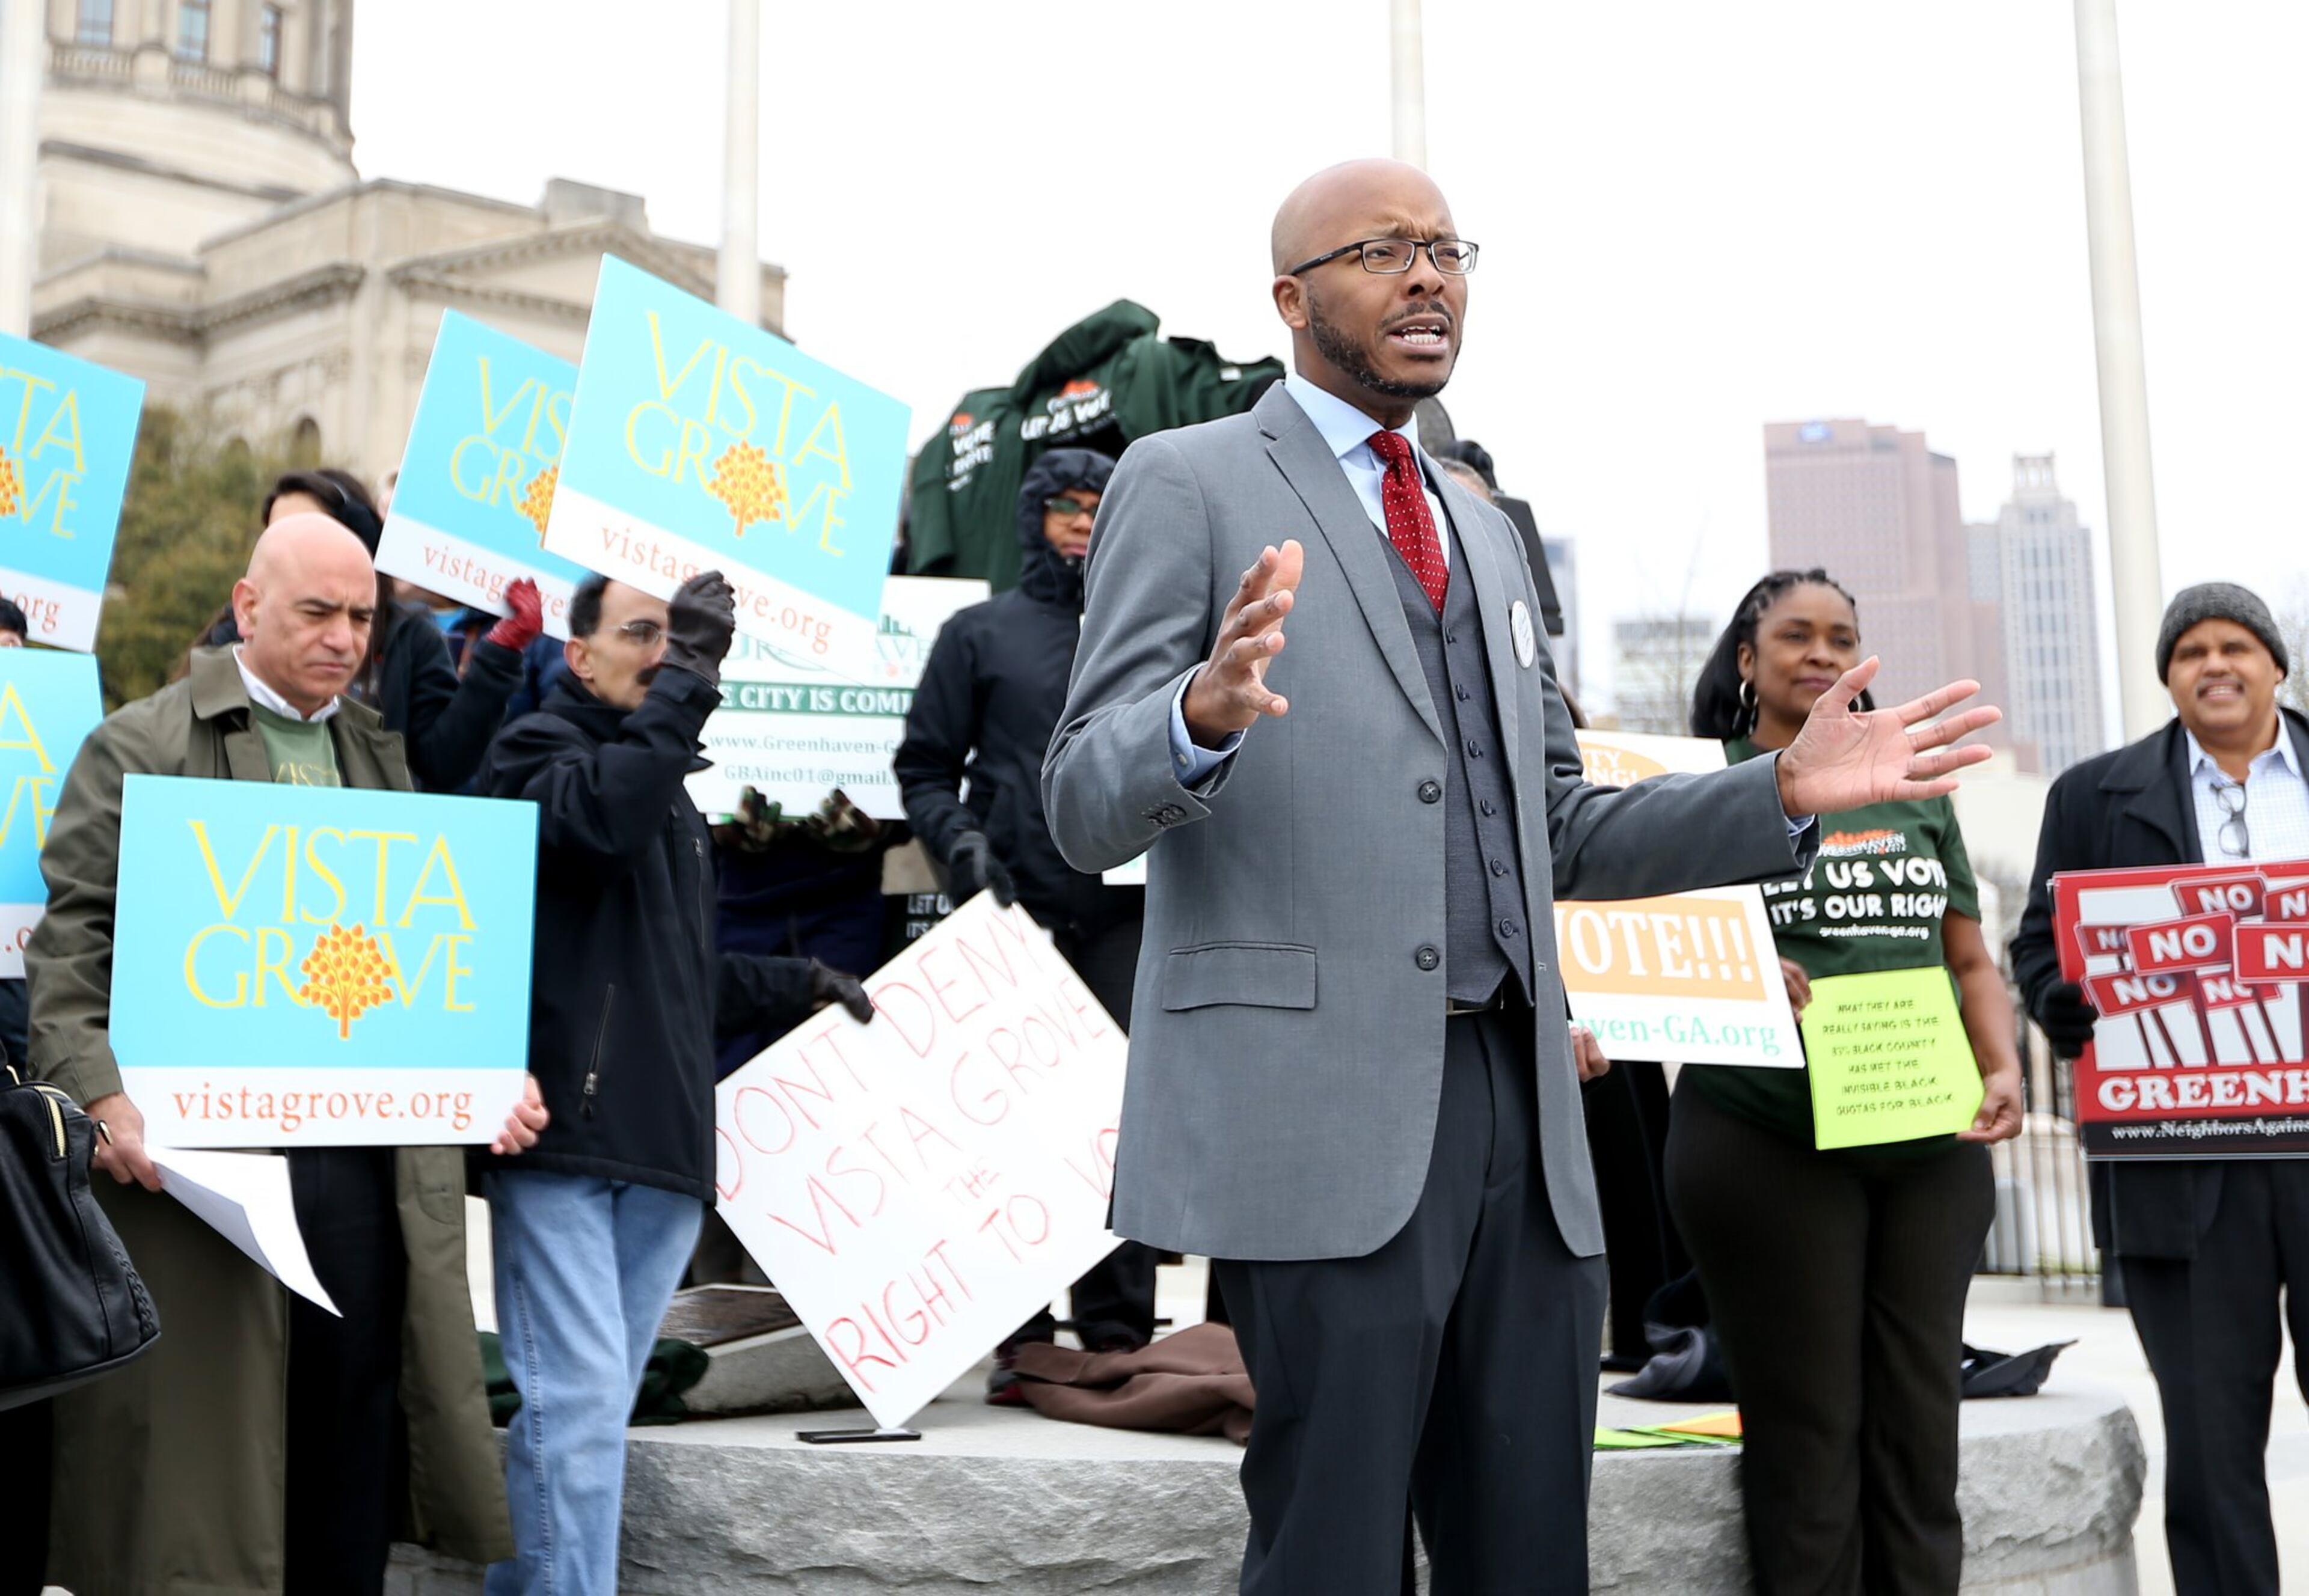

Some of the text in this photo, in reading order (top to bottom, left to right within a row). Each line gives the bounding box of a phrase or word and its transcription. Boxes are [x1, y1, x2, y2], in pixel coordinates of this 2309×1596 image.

[477, 356, 572, 465] VIS
[646, 310, 852, 492] VISTA
[740, 685, 805, 711] CITY
[808, 687, 834, 712] IS
[839, 688, 913, 715] COMI
[710, 735, 897, 754] www.Greenhaven-G
[724, 764, 895, 787] GBAinc01@gmail.
[187, 820, 477, 930] VISTA
[1825, 860, 1874, 889] US
[1770, 897, 1817, 925] IT'S
[1824, 894, 1884, 920] OUR
[2197, 884, 2254, 913] NO
[2148, 924, 2217, 963] NO
[869, 907, 1045, 1058] DENY
[2111, 973, 2177, 1006] NO
[1894, 999, 1914, 1010] ARE
[1915, 1017, 1939, 1027] THE
[1852, 1042, 1883, 1056] BLACK
[1886, 1038, 1936, 1051] COUNTY
[1896, 1059, 1919, 1071] THE
[1894, 1076, 1938, 1091] BLACK
[173, 1082, 473, 1132] vistagrove.org
[1909, 1093, 1954, 1108] BLACK
[767, 978, 1107, 1256] VISTA GROVE
[2111, 1117, 2309, 1140] www.NeighborsAgains
[942, 1155, 1002, 1206] THE
[824, 1238, 973, 1394] RIGHT
[978, 1193, 1050, 1264] TO
